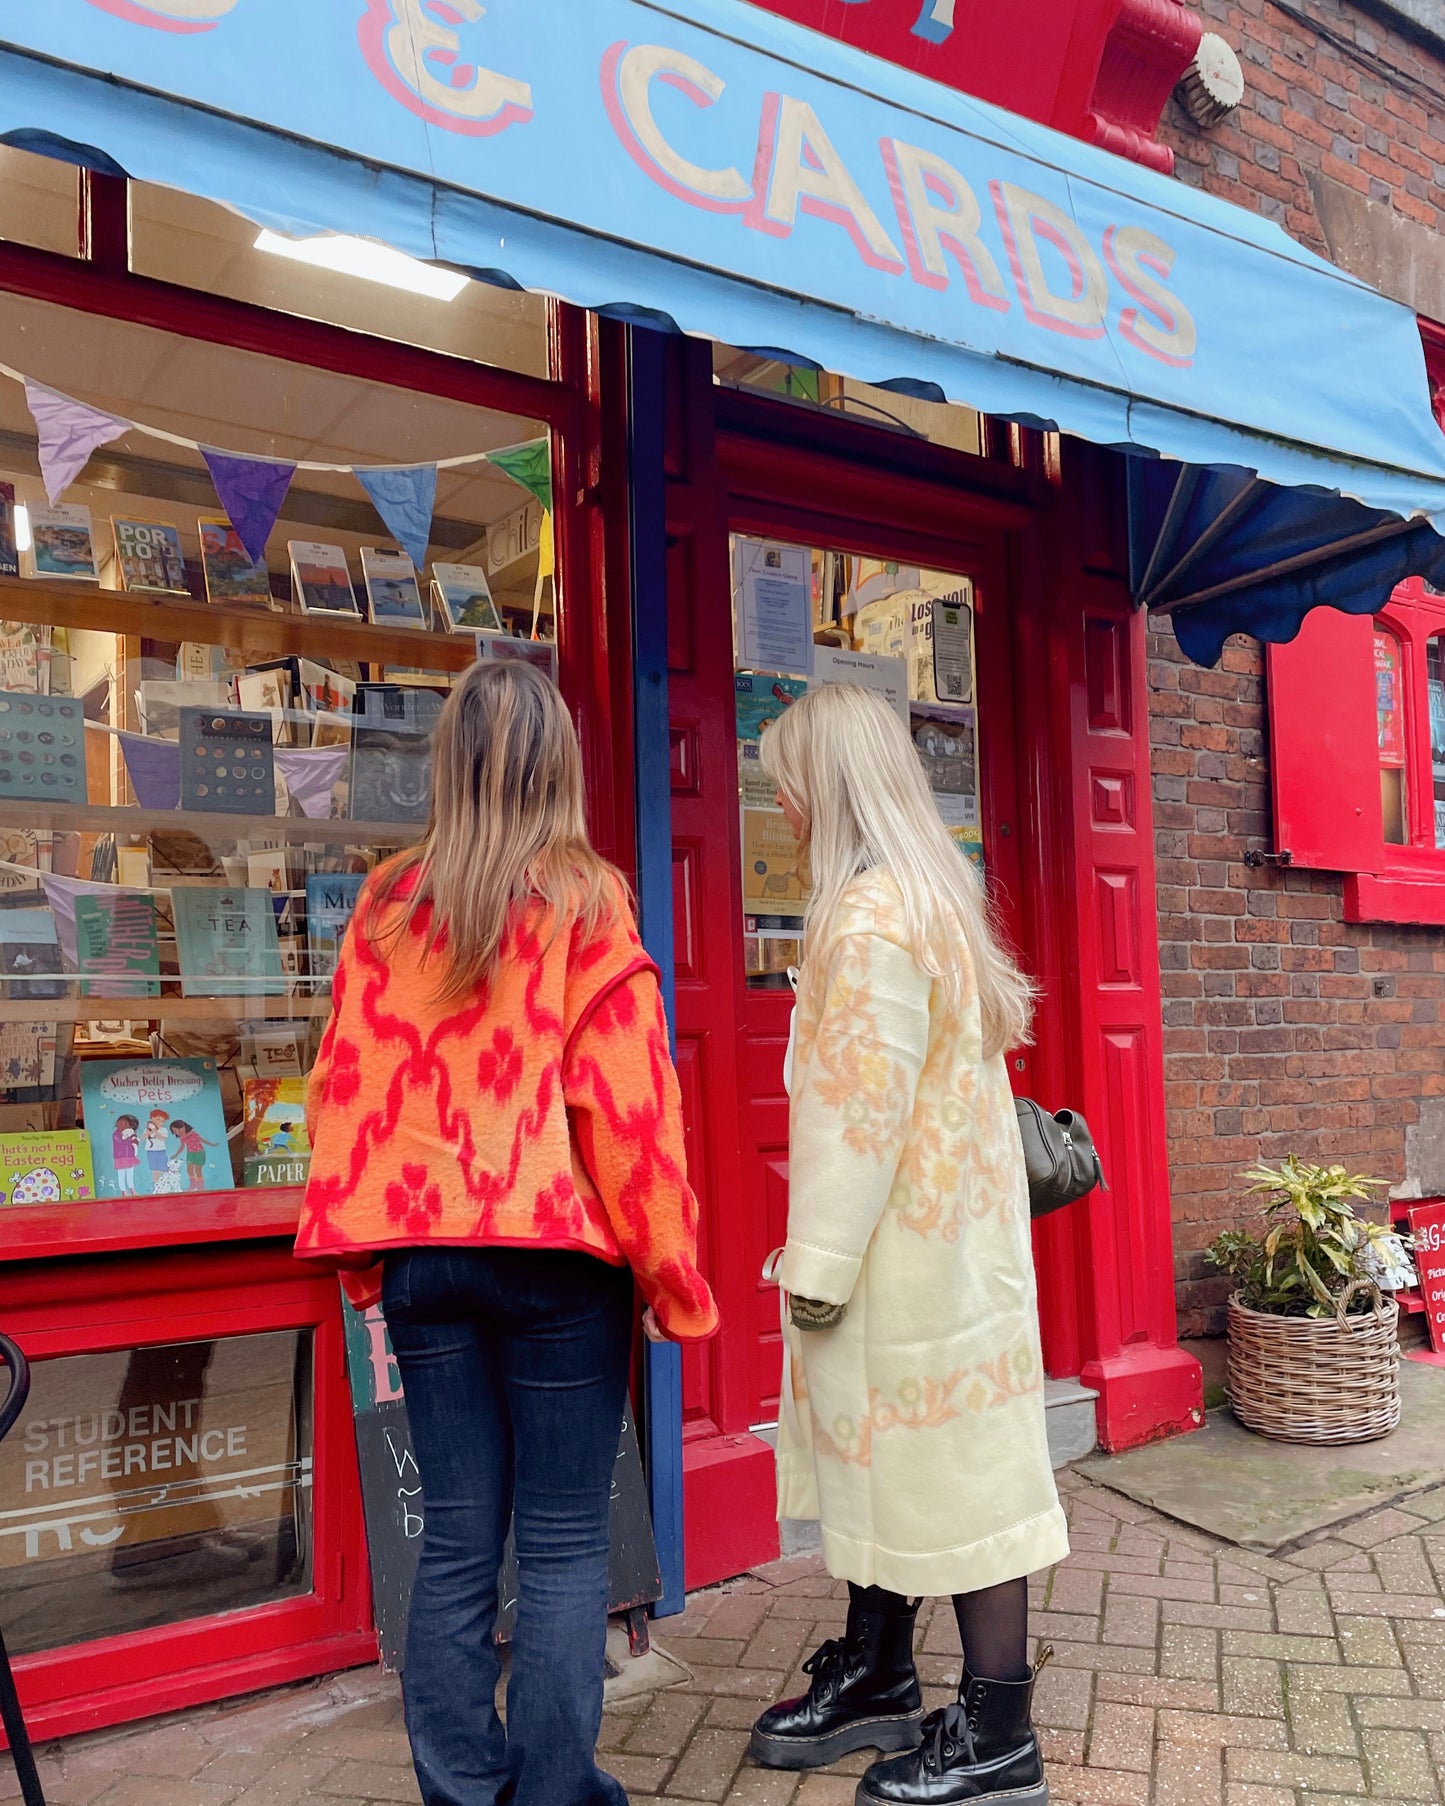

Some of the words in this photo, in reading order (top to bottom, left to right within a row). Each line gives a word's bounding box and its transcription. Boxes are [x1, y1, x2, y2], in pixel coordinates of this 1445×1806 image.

[602, 41, 1197, 368] CARDS
[120, 523, 167, 546] POR
[122, 540, 152, 559] TO
[832, 657, 857, 668] Opening
[208, 918, 252, 932] TEA
[110, 1076, 139, 1089] Sticker
[138, 1089, 172, 1102] Pets
[0, 1143, 28, 1155] hat's
[32, 1143, 52, 1153] not
[4, 1155, 47, 1167] Easter
[50, 1155, 74, 1167] egg
[256, 1163, 306, 1184] PAPER
[24, 1399, 199, 1453] STUDENT
[25, 1426, 248, 1492] REFERENCE
